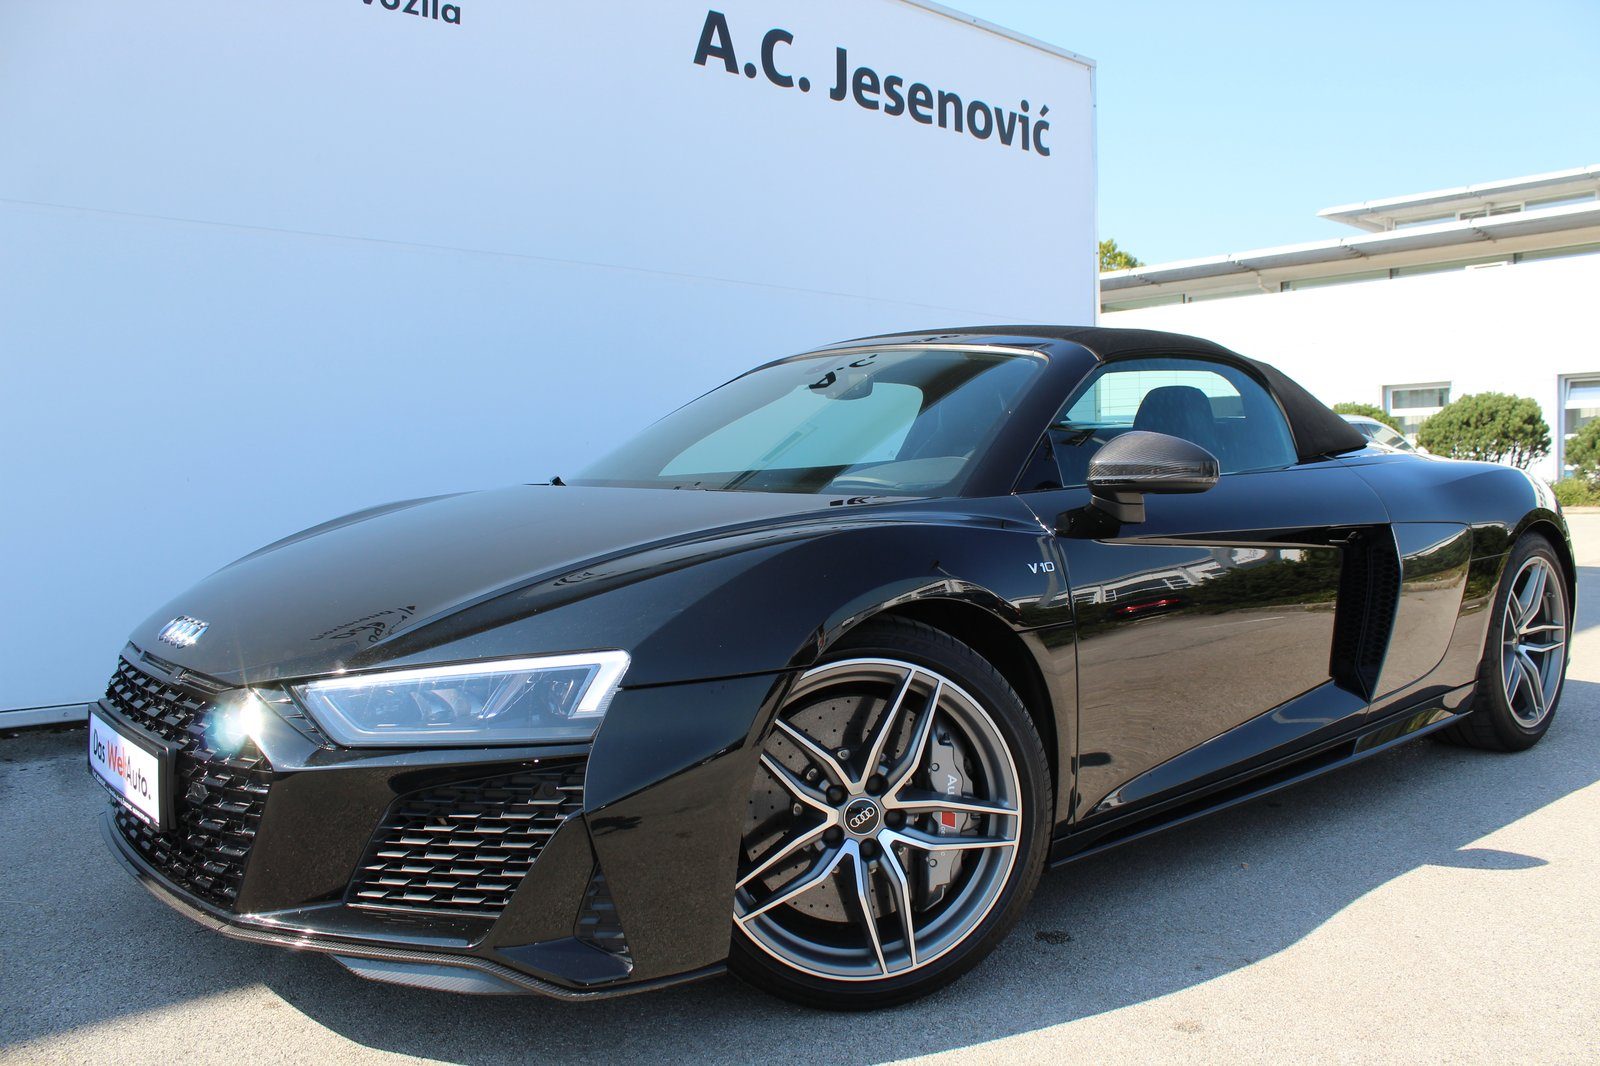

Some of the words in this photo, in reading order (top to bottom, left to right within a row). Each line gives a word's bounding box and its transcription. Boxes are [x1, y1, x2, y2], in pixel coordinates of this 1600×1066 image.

[362, 0, 461, 25] ozila
[693, 10, 811, 93] A.C.
[829, 47, 1051, 157] Jesenović
[93, 728, 106, 763] Das
[947, 774, 958, 795] Au
